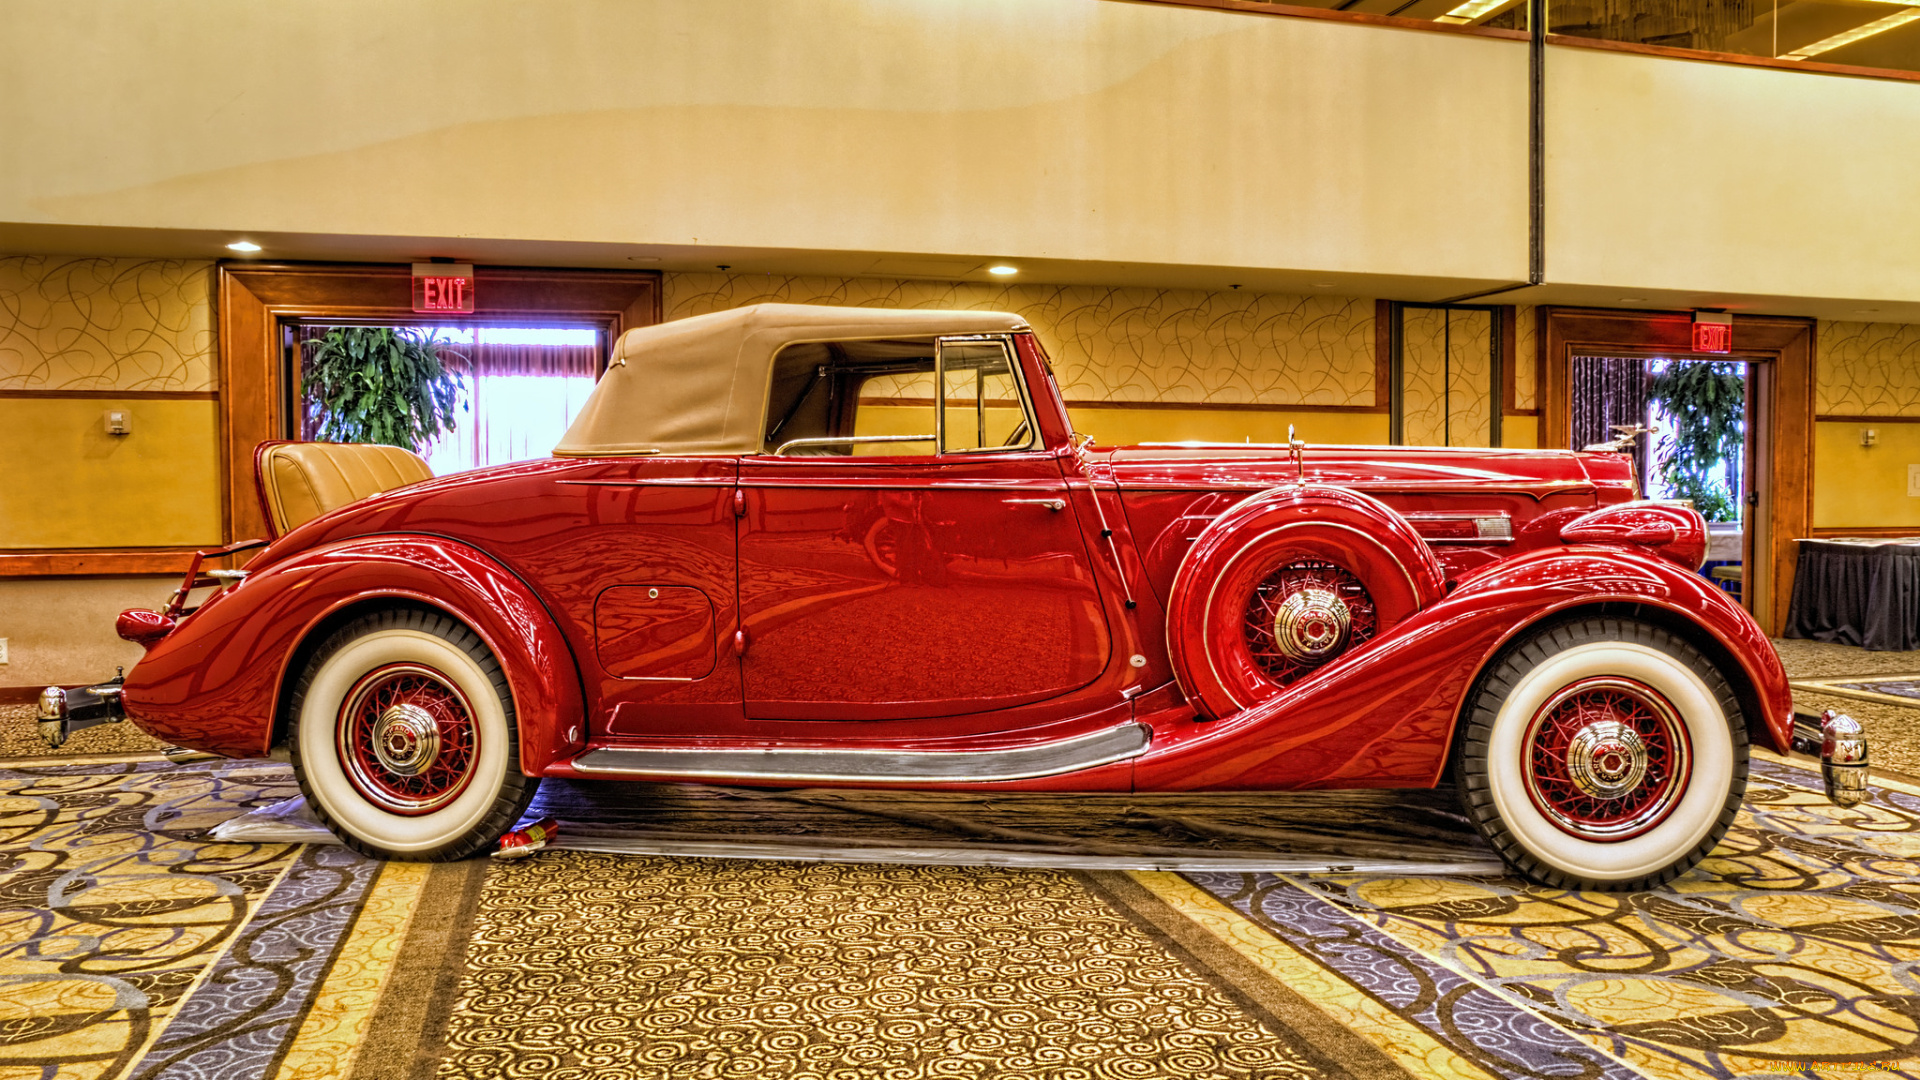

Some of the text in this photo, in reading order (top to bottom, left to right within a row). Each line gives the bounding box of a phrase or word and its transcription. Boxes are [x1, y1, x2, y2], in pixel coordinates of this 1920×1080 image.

[424, 278, 466, 309] EXIT
[1700, 325, 1726, 351] EXIT
[1297, 611, 1333, 629] PACKARD
